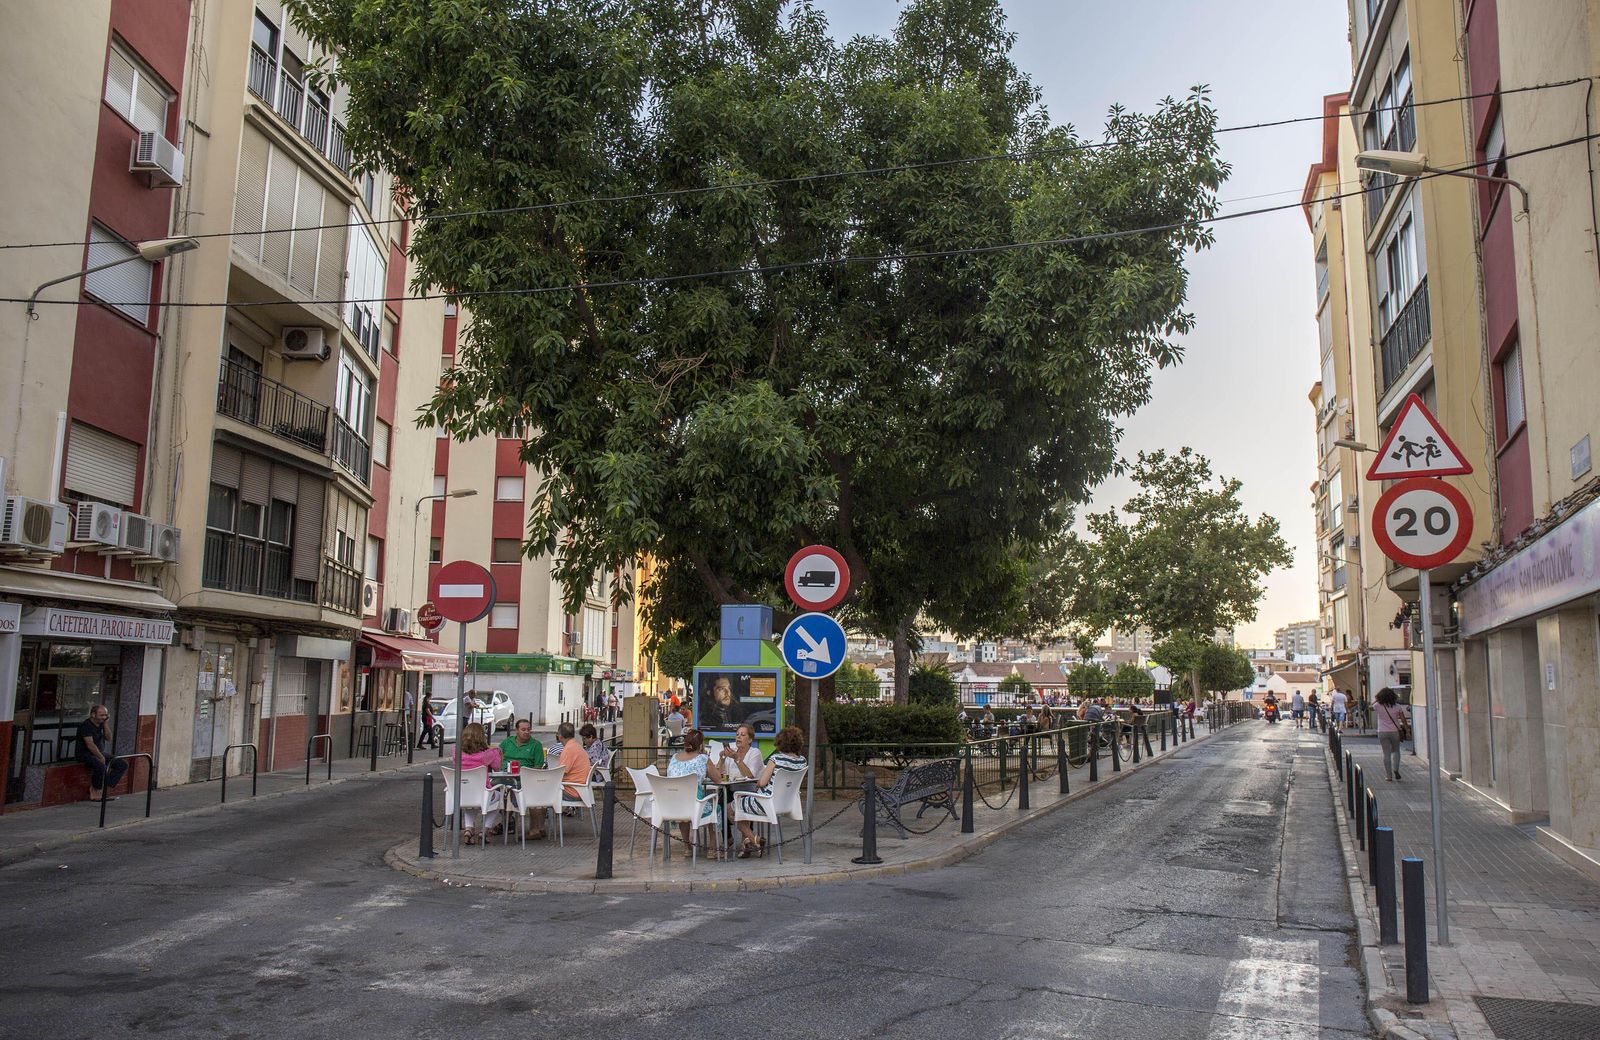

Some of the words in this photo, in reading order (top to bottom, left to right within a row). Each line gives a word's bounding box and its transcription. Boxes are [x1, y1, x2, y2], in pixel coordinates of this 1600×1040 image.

[1392, 506, 1451, 537] 20
[1519, 564, 1532, 595] SAN
[50, 614, 98, 635] CAFETERIA
[100, 619, 133, 639] PARQUE
[134, 622, 145, 638] DE
[145, 623, 156, 639] LA
[157, 625, 171, 641] LUZ
